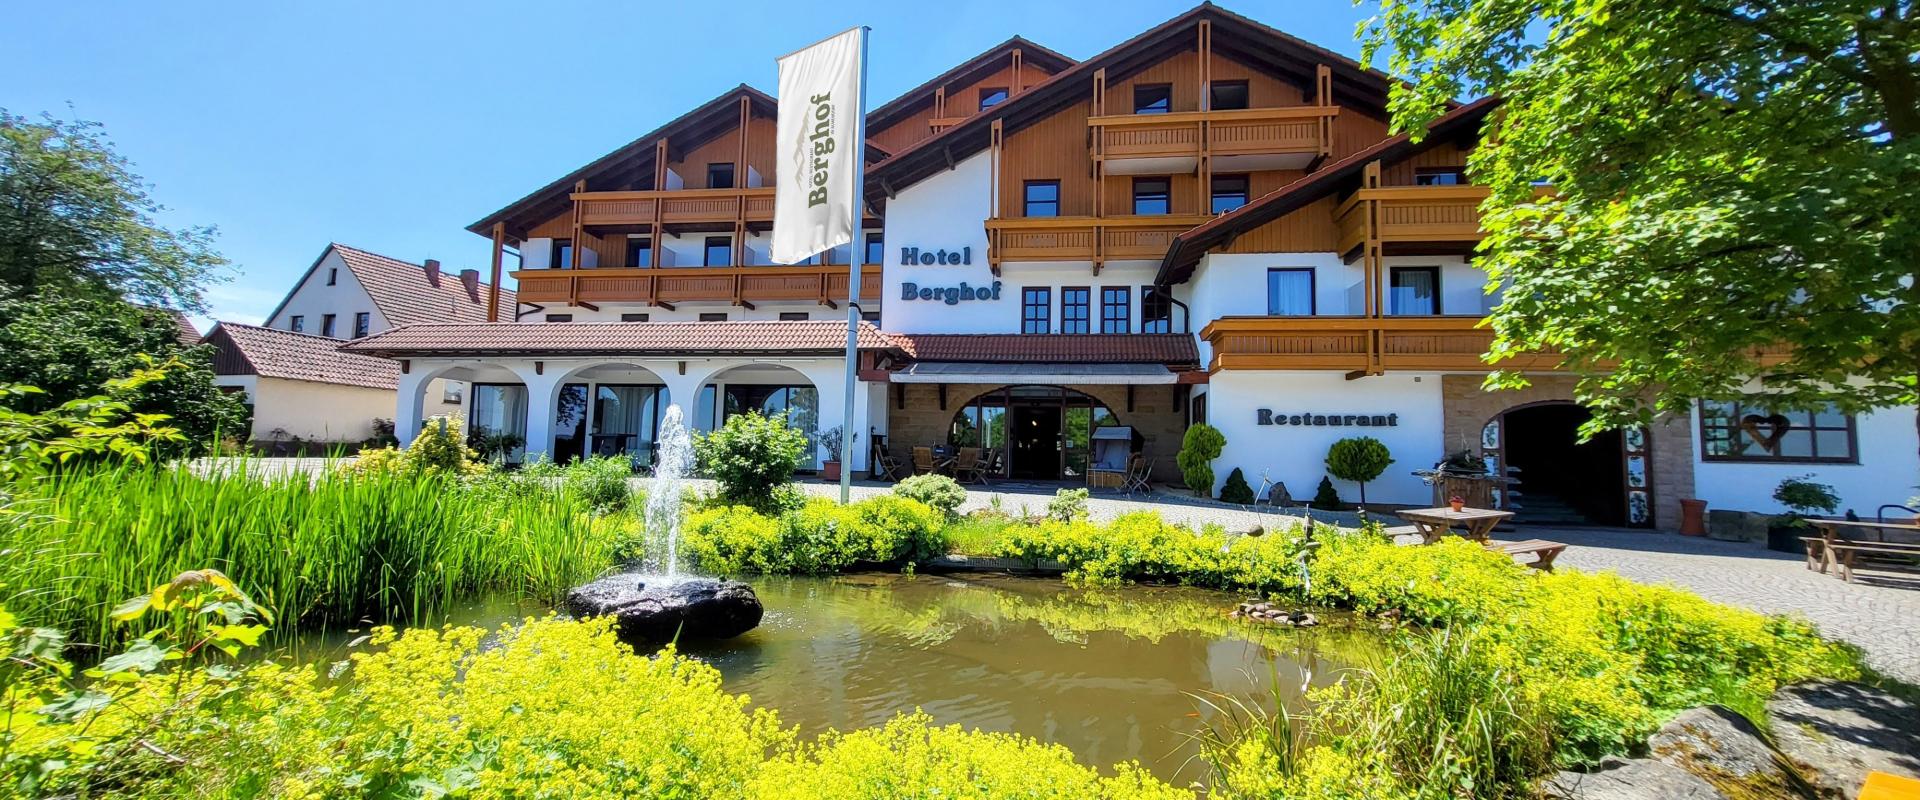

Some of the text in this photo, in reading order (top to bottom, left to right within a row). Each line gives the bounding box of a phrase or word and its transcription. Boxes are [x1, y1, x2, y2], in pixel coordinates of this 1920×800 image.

[808, 91, 835, 208] Berghof
[901, 246, 971, 266] Hotel
[901, 281, 1002, 306] Berghof
[1257, 408, 1399, 427] Restaurant
